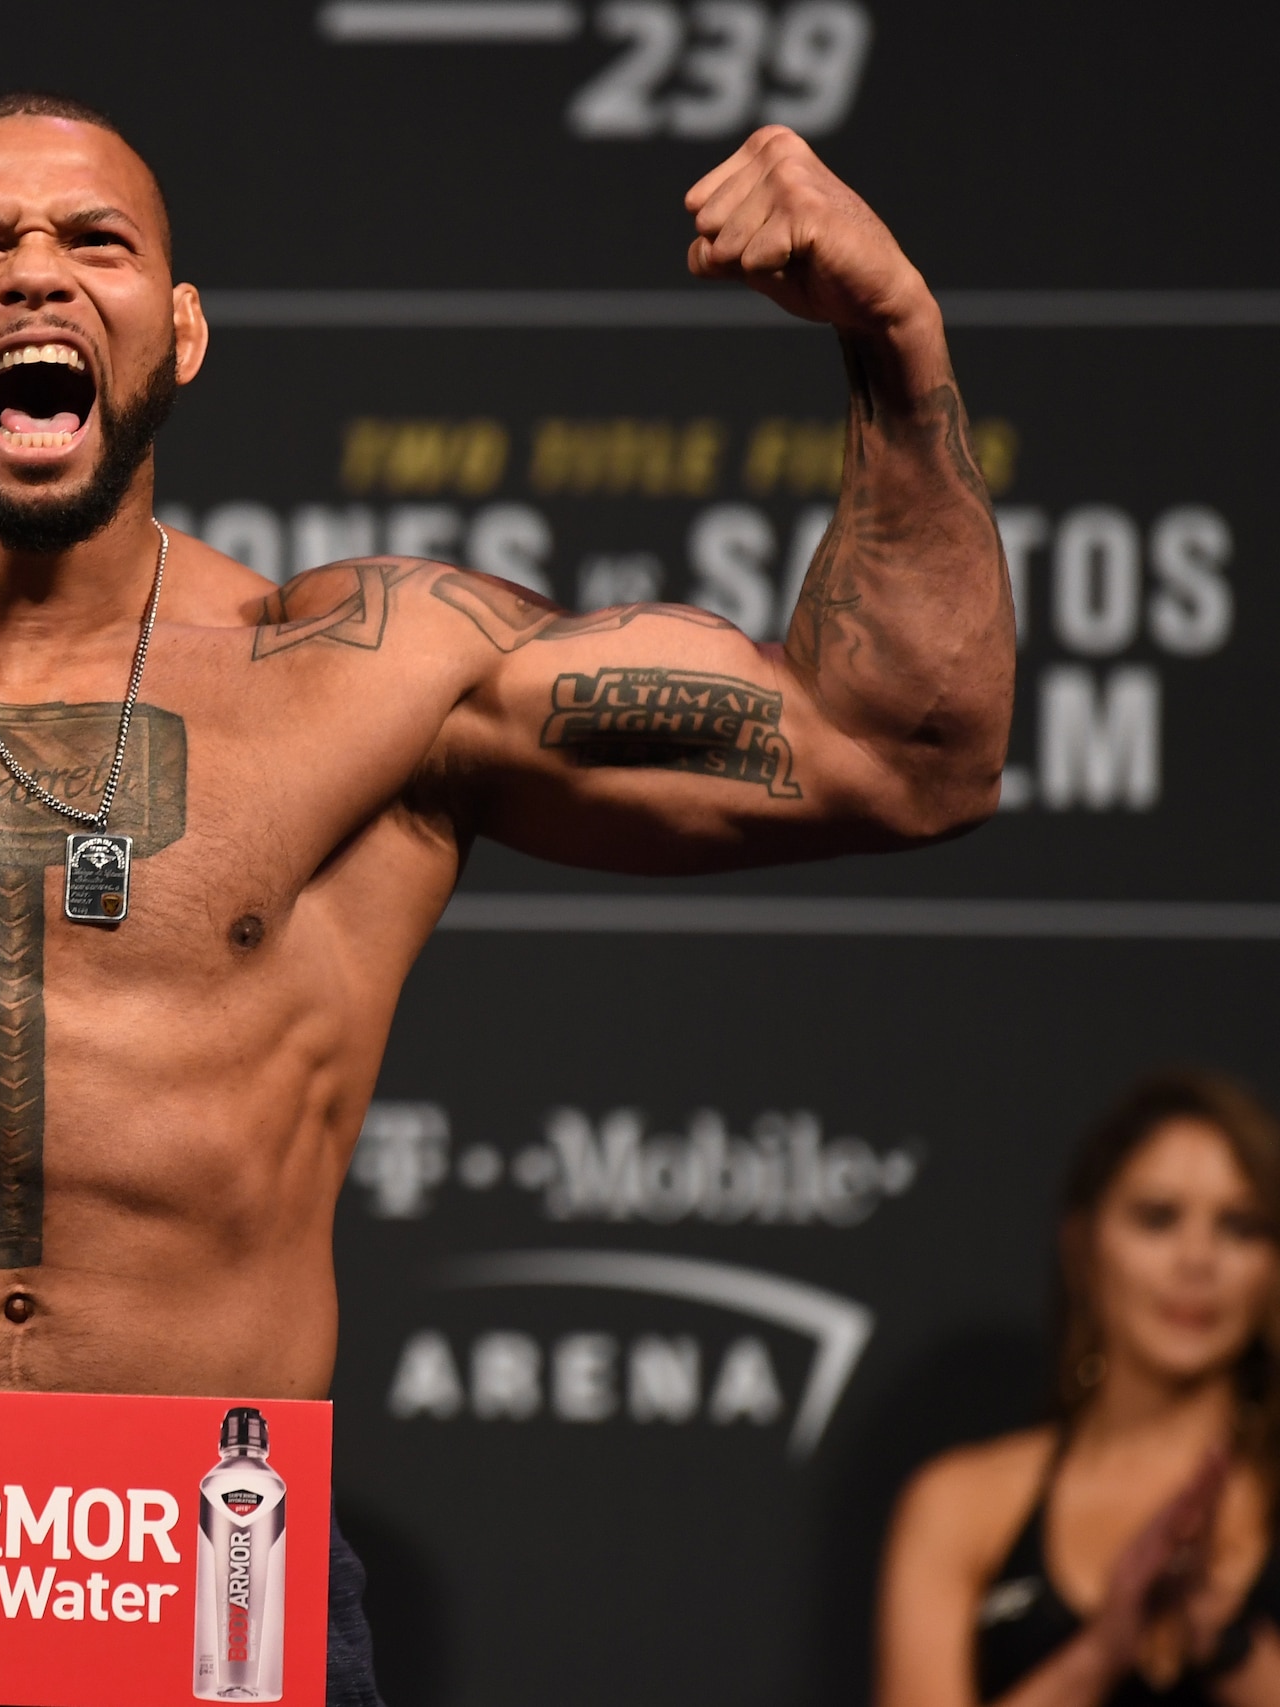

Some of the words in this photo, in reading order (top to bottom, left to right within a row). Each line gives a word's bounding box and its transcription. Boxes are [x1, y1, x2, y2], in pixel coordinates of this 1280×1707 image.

[572, 2, 870, 138] 239
[542, 709, 780, 750] FIGHTER
[553, 670, 782, 720] ULTIMATE
[388, 1330, 784, 1426] ARENA
[228, 1531, 251, 1662] BODYARMOR
